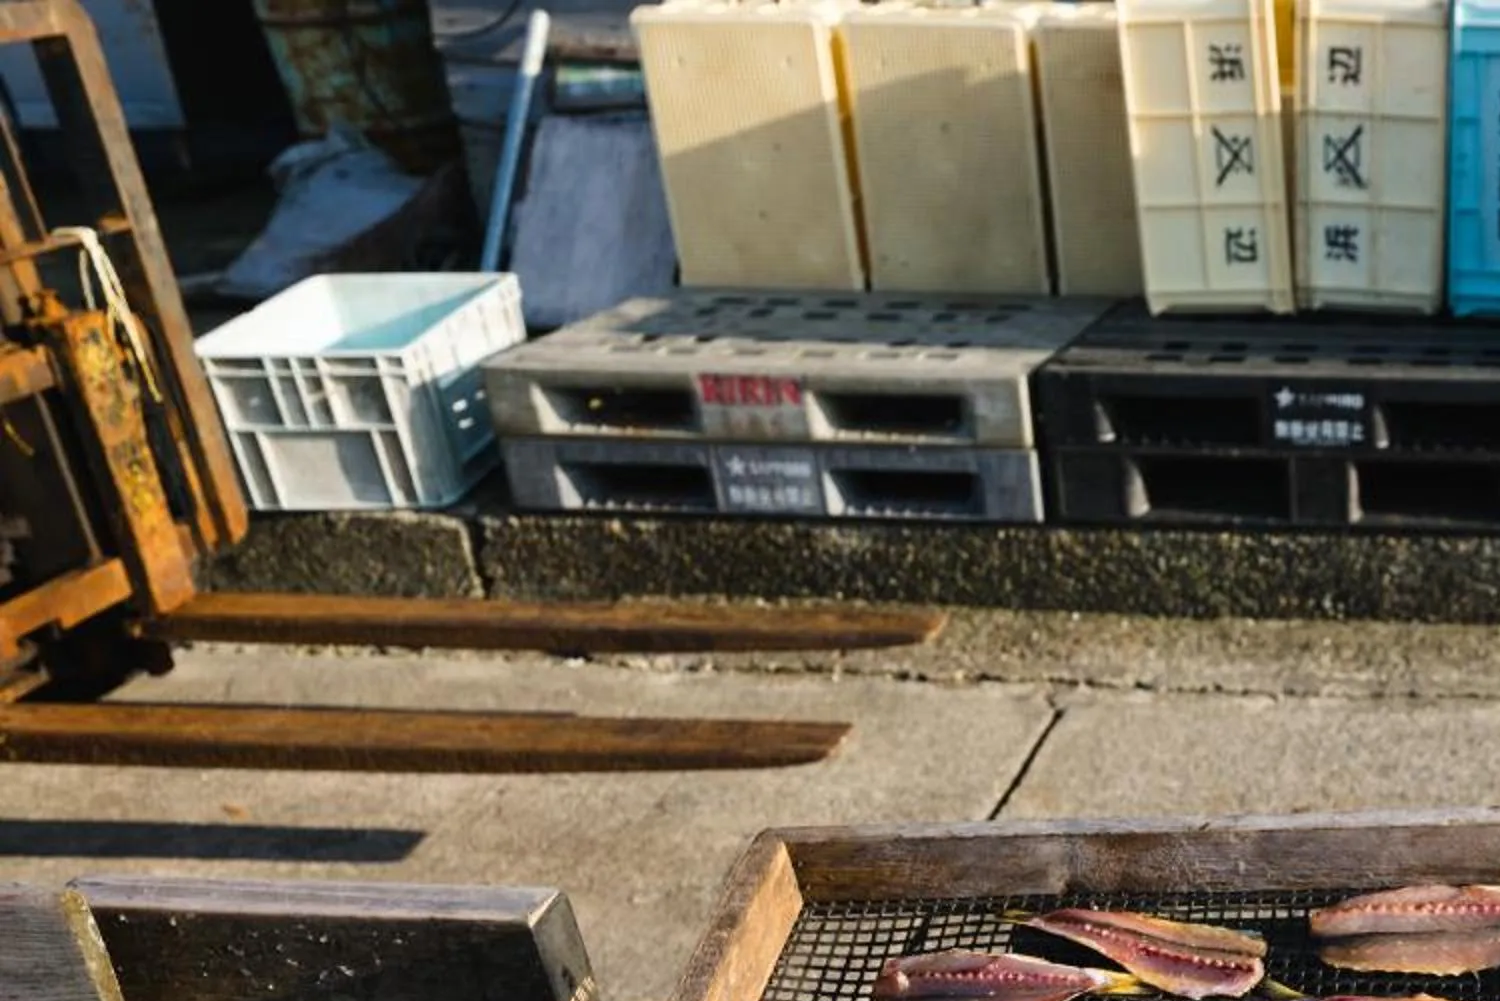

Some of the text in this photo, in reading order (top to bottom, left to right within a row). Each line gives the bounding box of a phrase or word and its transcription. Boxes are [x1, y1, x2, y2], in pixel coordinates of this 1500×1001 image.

[1208, 44, 1258, 265] 浜 辺
[1324, 46, 1361, 263] 浜 辺
